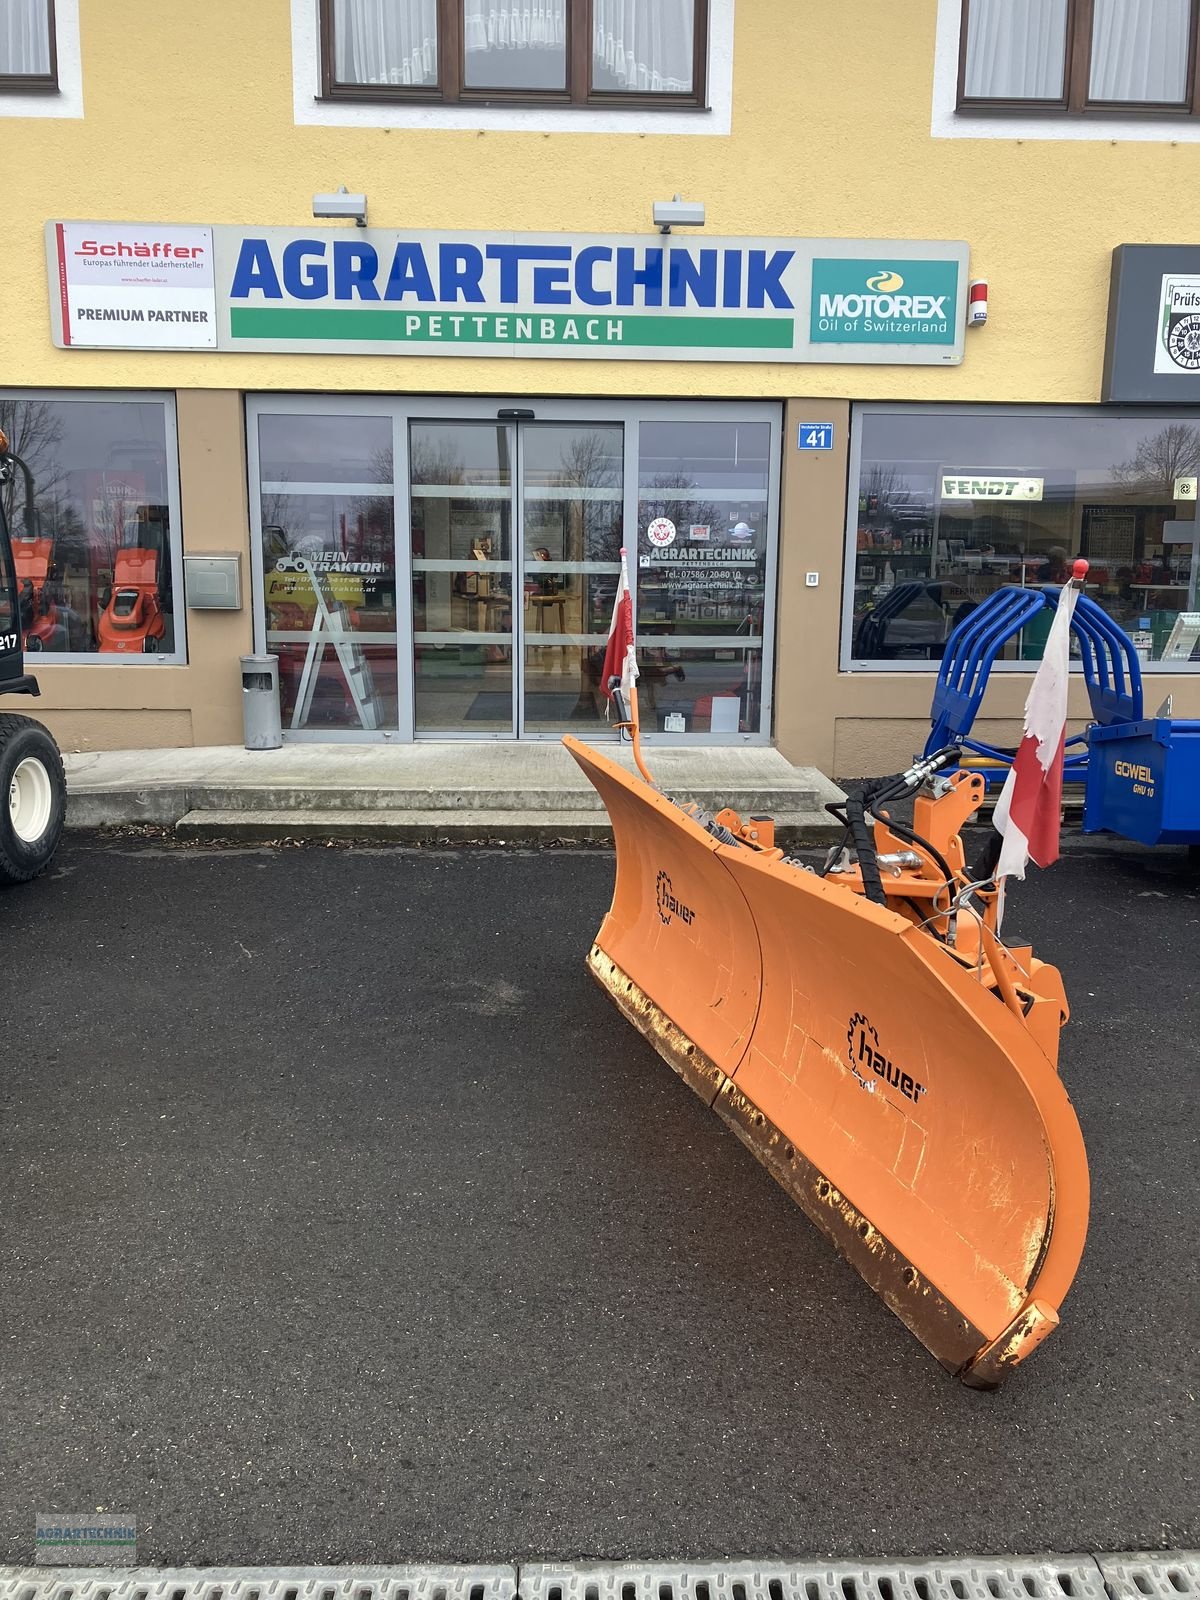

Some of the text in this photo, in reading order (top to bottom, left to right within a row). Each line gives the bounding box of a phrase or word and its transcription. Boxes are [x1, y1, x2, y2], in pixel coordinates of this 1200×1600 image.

[75, 240, 204, 258] Schäffer
[83, 258, 204, 269] Europas führender Laderhersteller
[229, 238, 796, 309] AGRARTECHNIK
[820, 294, 947, 319] MOTOREX
[77, 308, 208, 323] PREMIUM PARTNER
[405, 315, 624, 342] PETTENBACH
[818, 318, 947, 334] Oil of Switzerland
[806, 430, 825, 446] 41
[944, 480, 1019, 496] FENDT
[310, 552, 349, 562] MEIN
[650, 548, 757, 560] AGRARTECHNIK
[312, 562, 382, 572] TRAKTOR
[662, 882, 695, 926] hauer
[859, 1030, 922, 1104] hauer
